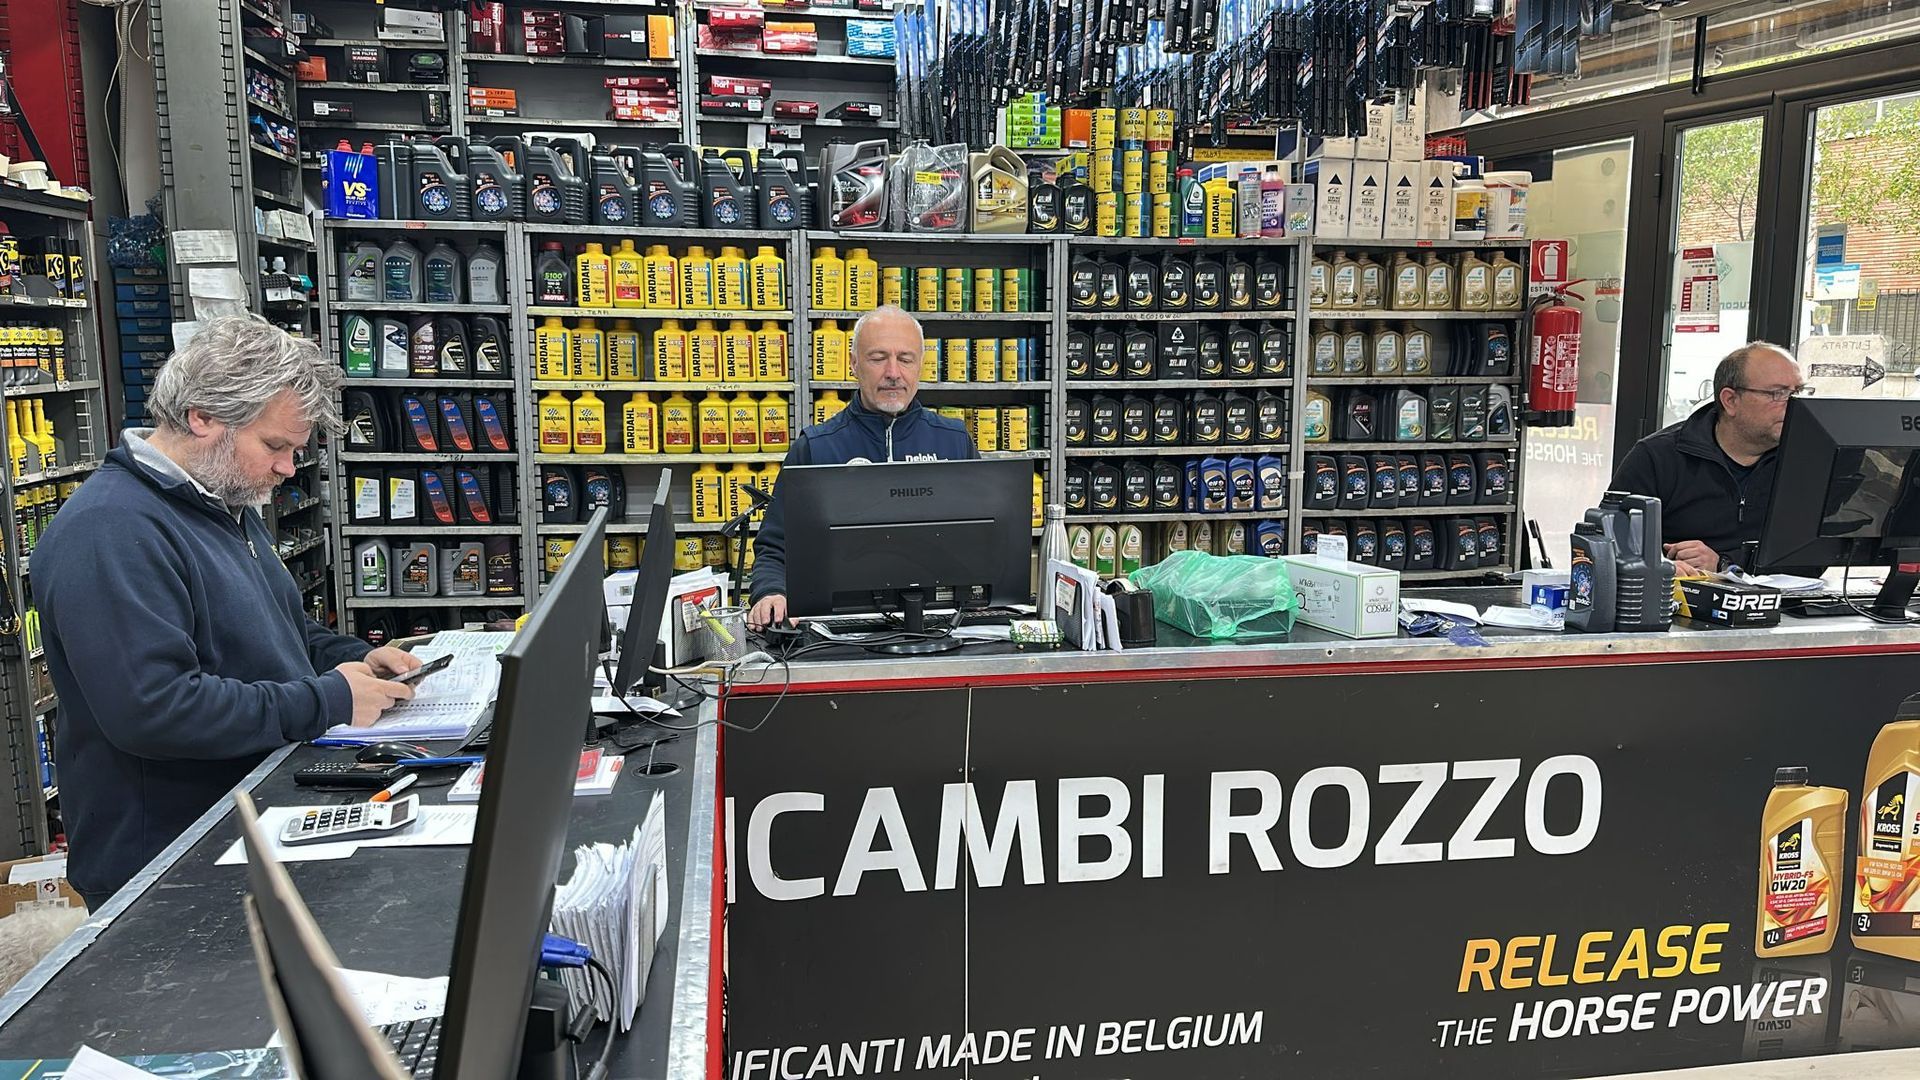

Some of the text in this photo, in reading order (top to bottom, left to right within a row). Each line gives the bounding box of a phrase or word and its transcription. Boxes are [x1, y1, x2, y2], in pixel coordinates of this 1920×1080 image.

[343, 181, 367, 198] VS
[1212, 194, 1220, 234] BARDAHL
[48, 254, 64, 279] K9
[582, 259, 591, 303] BARDAHL
[647, 261, 657, 304] BARDAHL
[685, 262, 694, 304] BARDAHL
[719, 262, 728, 305] BARDAHL
[758, 263, 766, 306] BARDAHL
[815, 263, 824, 306] BARDAHL
[850, 265, 858, 307] BARDAHL
[540, 332, 548, 375] BARDAHL
[573, 333, 581, 375] BARDAHL
[610, 334, 618, 376] BARDAHL
[659, 335, 667, 377] BARDAHL
[692, 335, 700, 377] BARDAHL
[727, 335, 735, 377] BARDAHL
[758, 335, 766, 377] BARDAHL
[816, 335, 824, 375] BARDAHL
[627, 408, 635, 449] BARDAHL
[696, 477, 704, 518] BARDAHL
[730, 476, 738, 517] BARDAHL
[889, 487, 934, 498] PHILIPS
[1207, 754, 1602, 875] ROZZO
[1876, 822, 1901, 833] KROSS
[1773, 870, 1814, 880] HYBRID-FS
[1778, 851, 1799, 860] KROSS
[1771, 879, 1806, 892] 0W20
[1457, 922, 1730, 993] RELEASE
[1437, 976, 1828, 1048] THE HORSE POWER
[914, 1027, 1036, 1071] MADE
[1044, 1023, 1085, 1060] IN
[1093, 1010, 1263, 1056] BELGIUM
